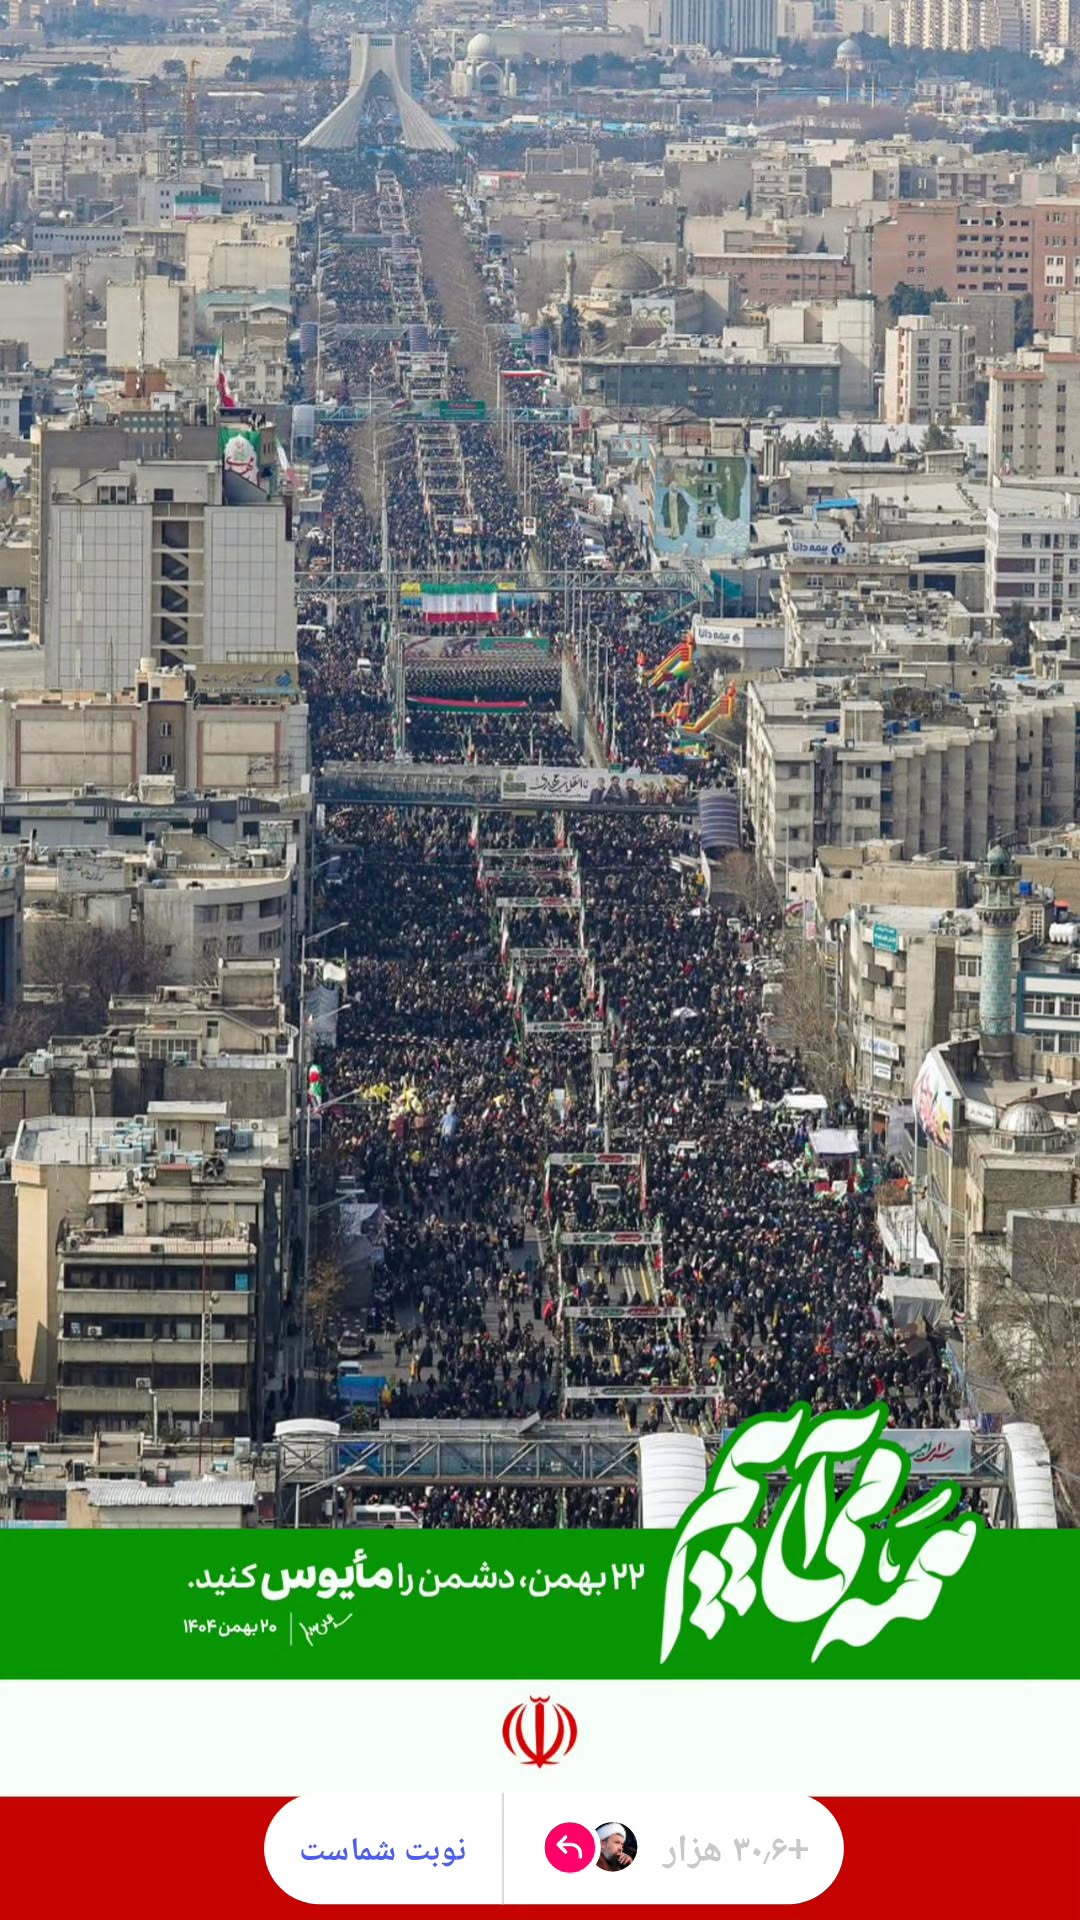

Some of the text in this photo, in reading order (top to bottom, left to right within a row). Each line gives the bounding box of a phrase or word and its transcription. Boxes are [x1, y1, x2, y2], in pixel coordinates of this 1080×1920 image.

[793, 542, 829, 555] بیمه دانا
[698, 628, 731, 643] بیمه دانا
